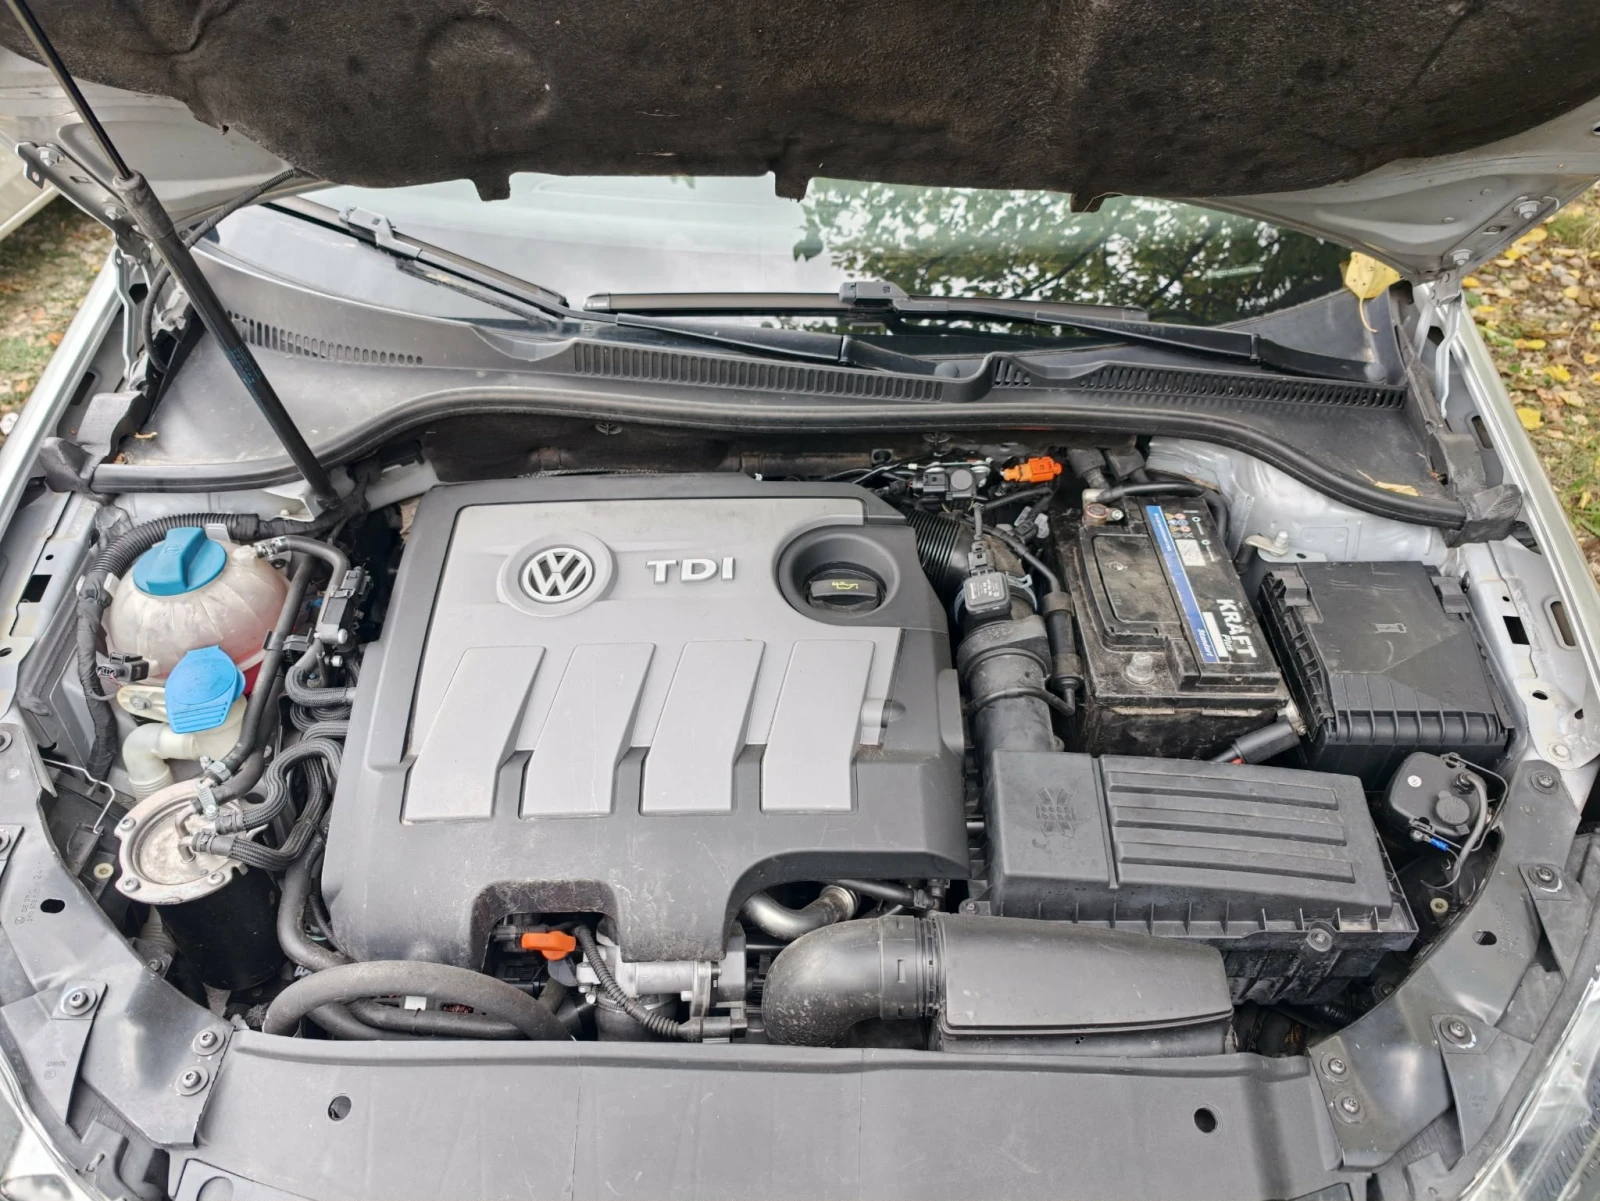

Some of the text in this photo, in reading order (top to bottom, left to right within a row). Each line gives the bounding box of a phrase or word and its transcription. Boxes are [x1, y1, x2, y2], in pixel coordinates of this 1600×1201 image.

[522, 547, 593, 602] VW
[646, 556, 736, 584] TDI
[1216, 599, 1258, 658] KRAFT
